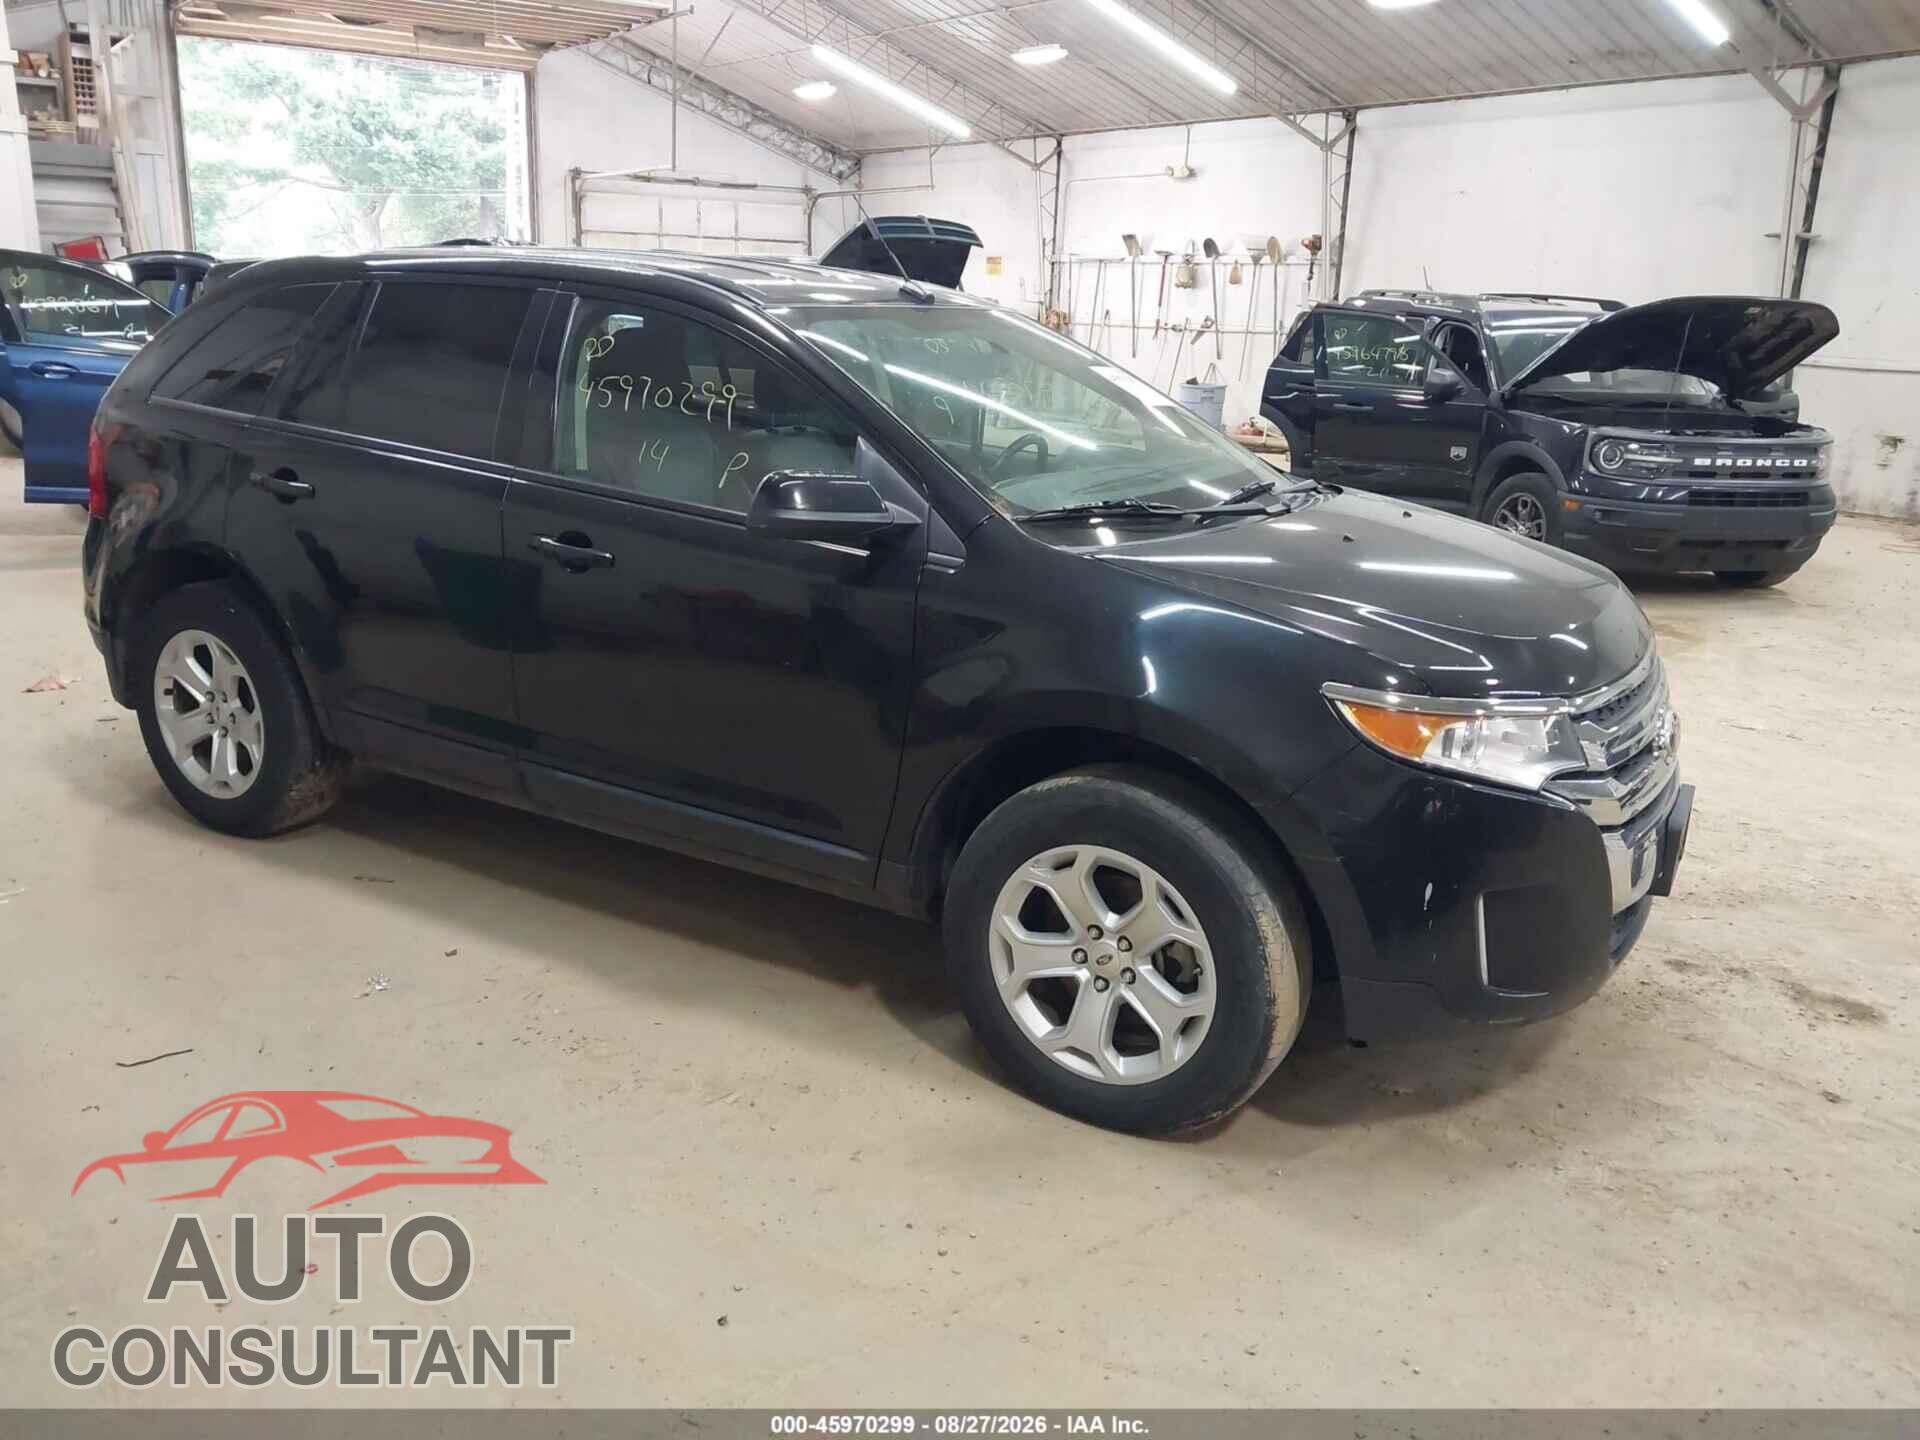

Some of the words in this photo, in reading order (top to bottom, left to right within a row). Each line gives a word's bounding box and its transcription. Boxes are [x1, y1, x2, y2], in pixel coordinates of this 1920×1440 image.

[578, 375, 738, 432] 45970299
[638, 439, 670, 473] 14
[717, 451, 750, 489] P
[1694, 458, 1808, 467] BRONCO
